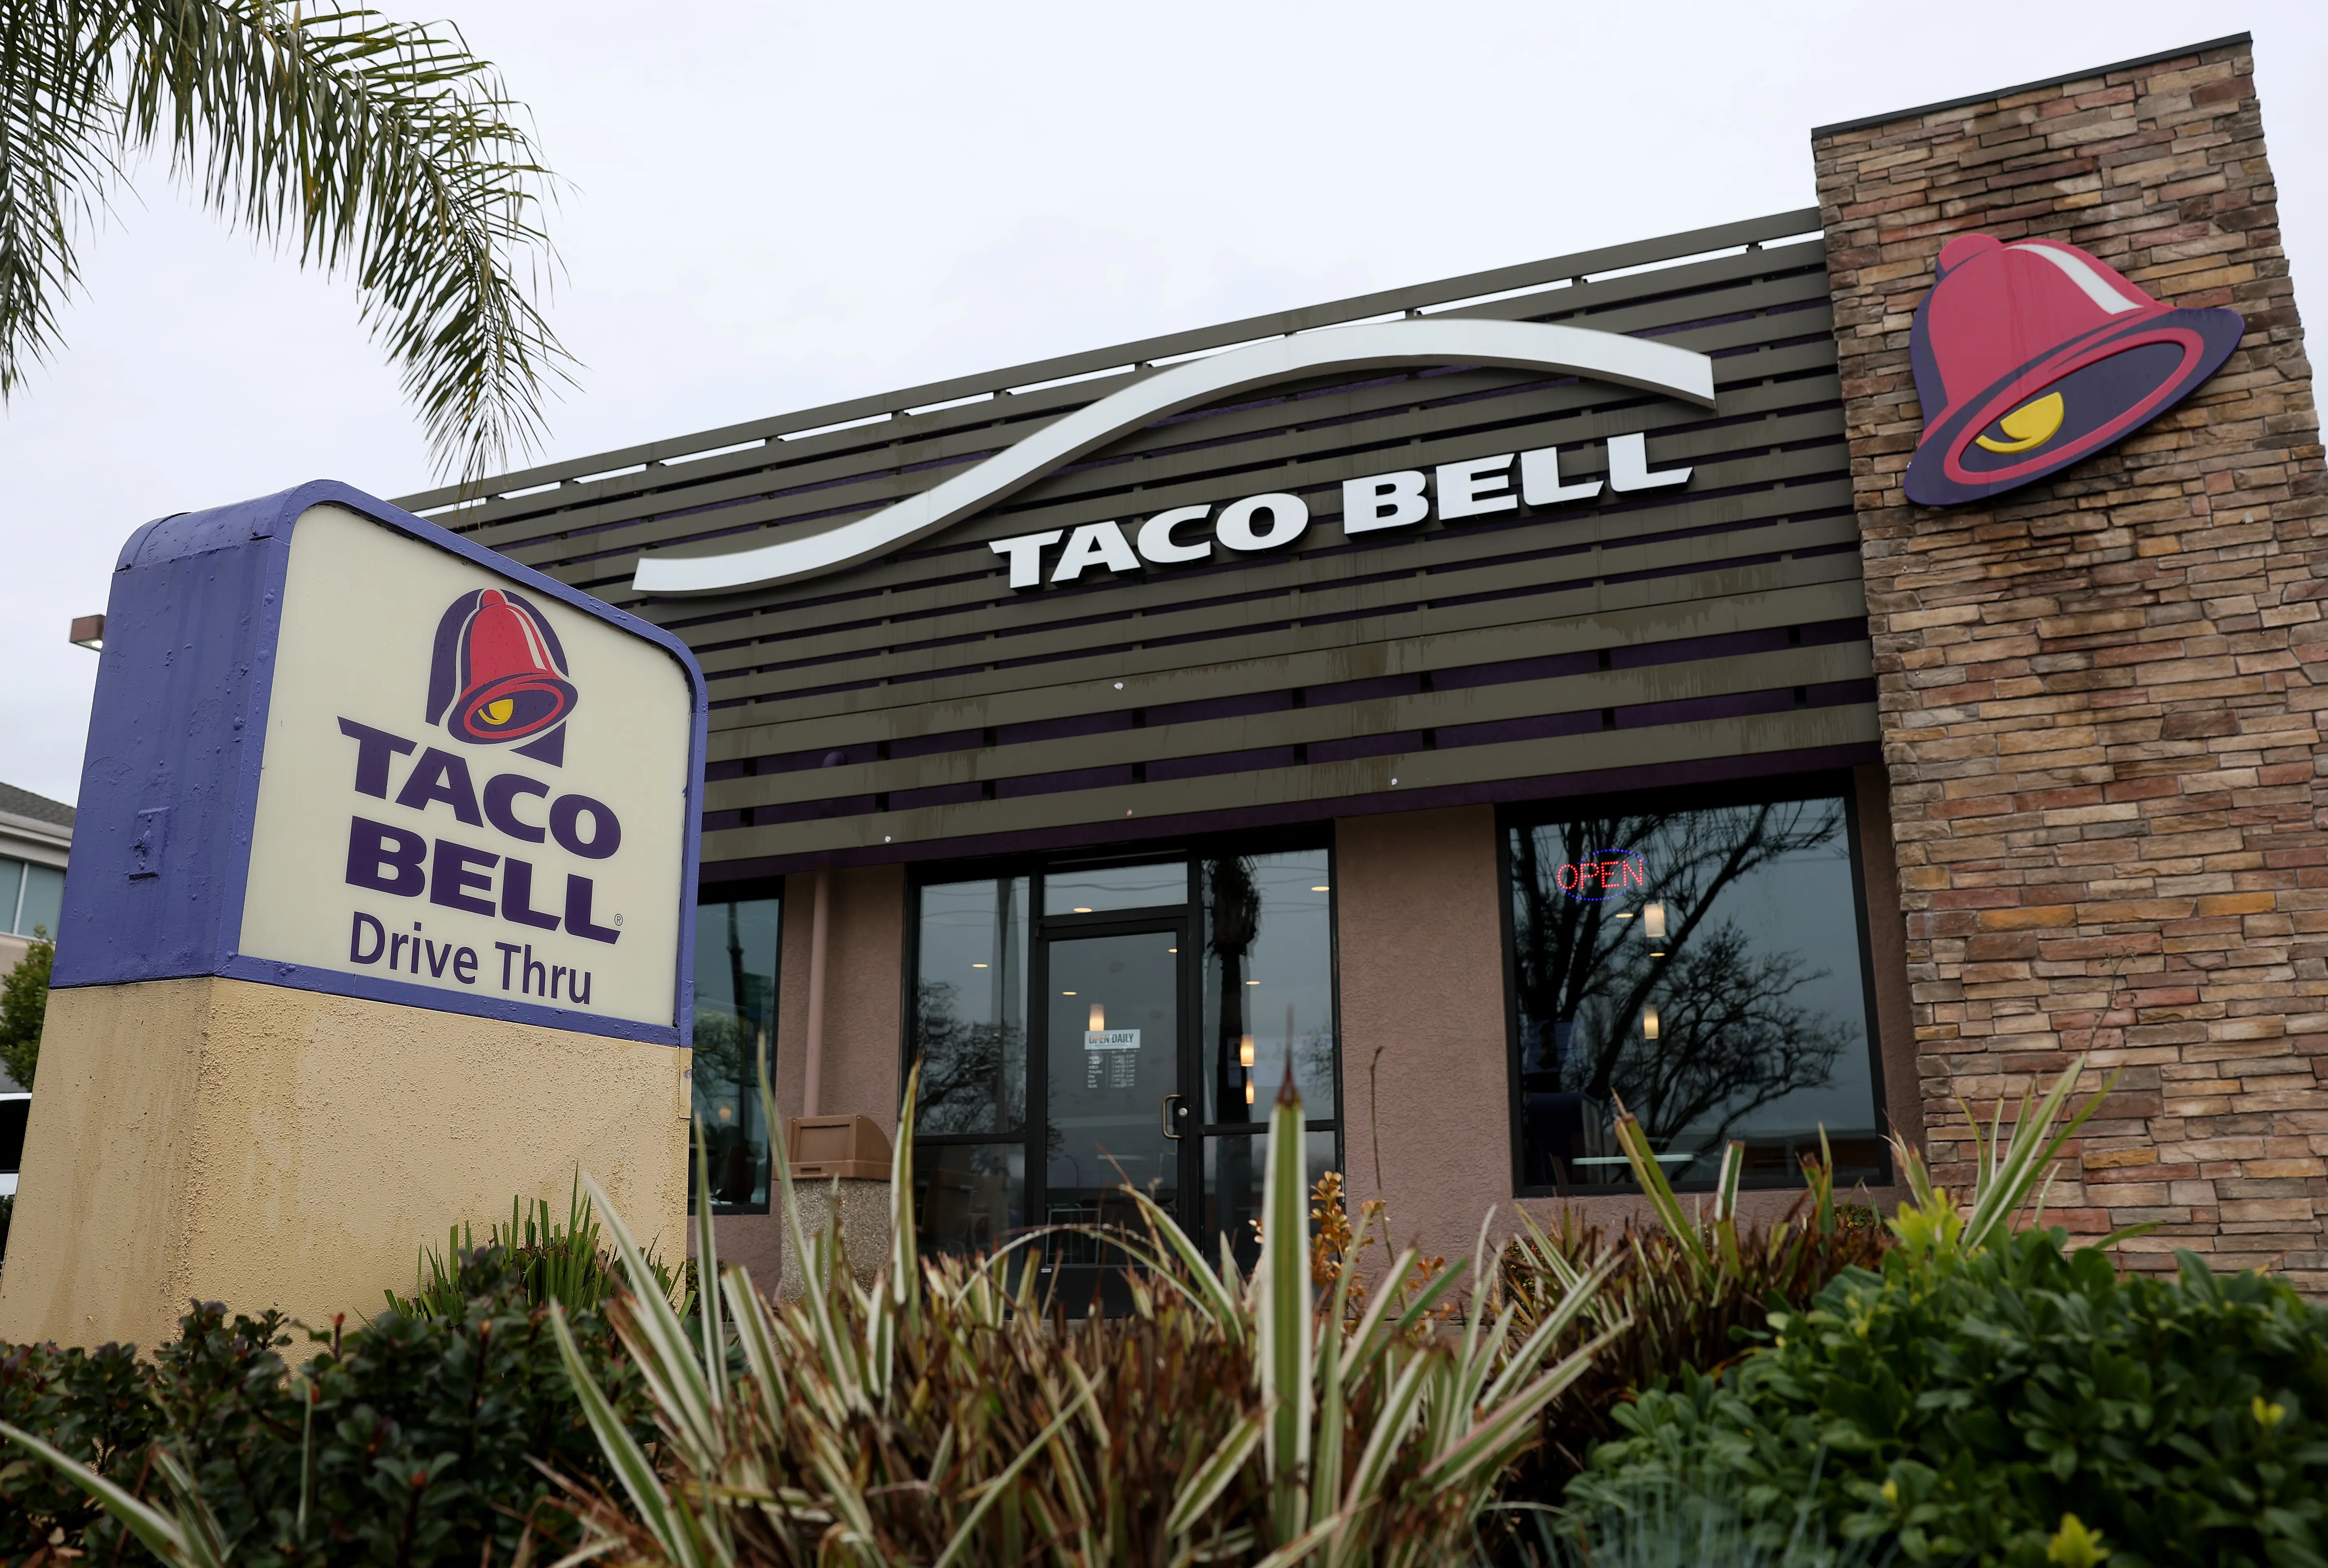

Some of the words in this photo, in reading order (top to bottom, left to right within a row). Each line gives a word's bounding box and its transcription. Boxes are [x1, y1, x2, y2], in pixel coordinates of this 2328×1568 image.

[988, 492, 1310, 589] TACO
[1342, 432, 1693, 536] BELL
[337, 716, 621, 860] TACO
[345, 815, 621, 944] BELL
[1557, 859, 1643, 889] OPEN
[350, 911, 478, 984] Drive
[494, 941, 591, 1005] Thru
[1112, 1033, 1134, 1043] DAILY
